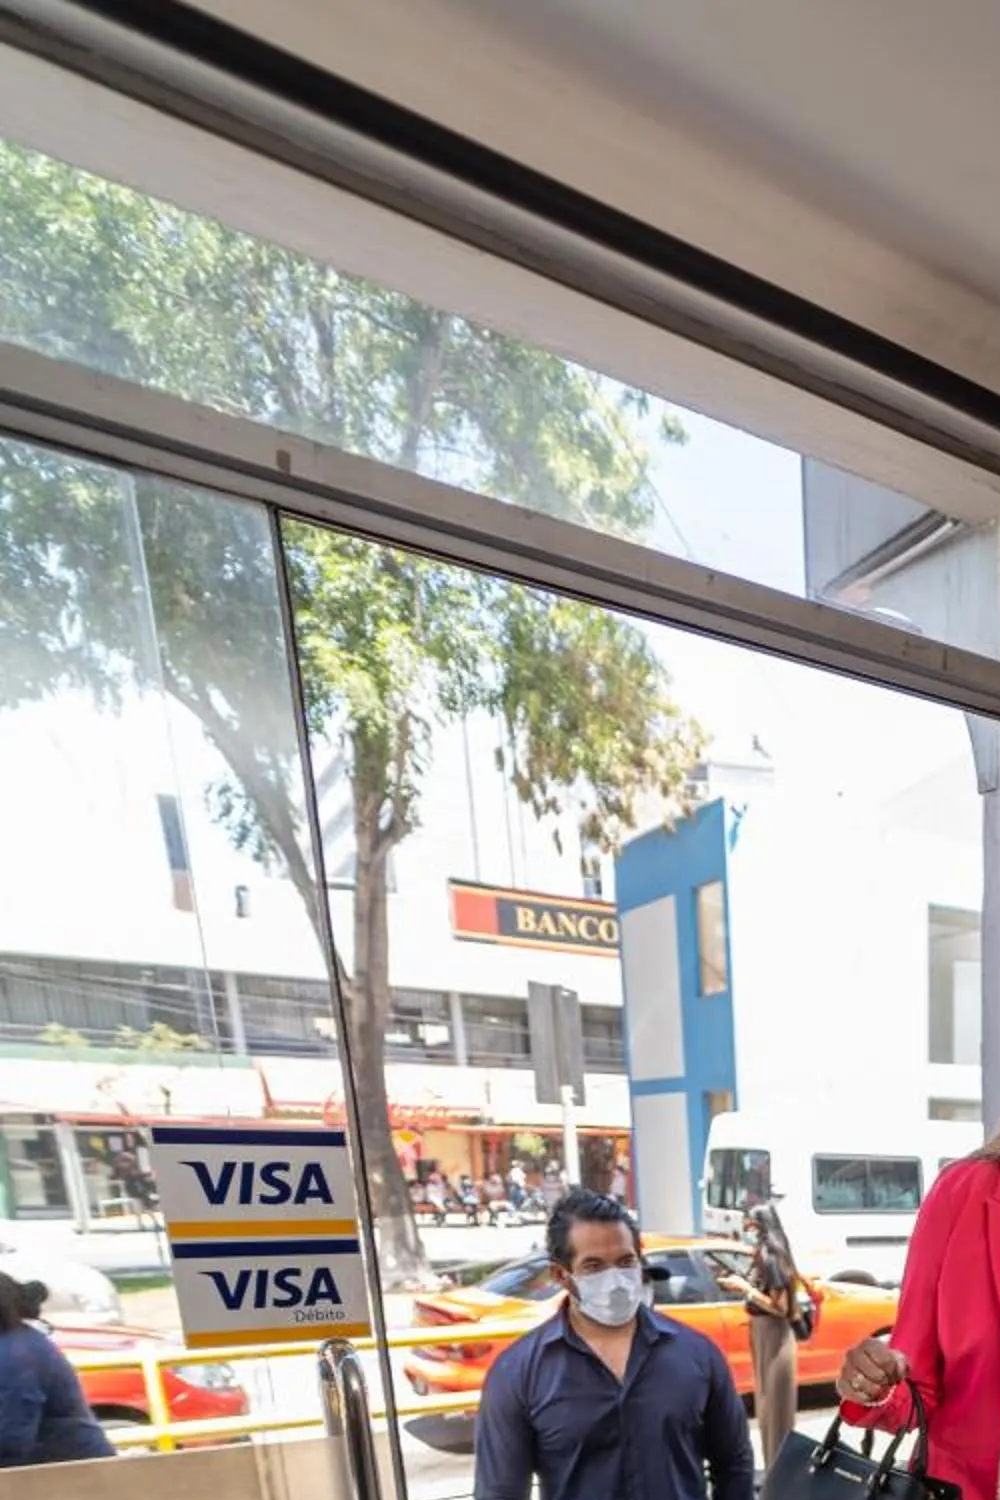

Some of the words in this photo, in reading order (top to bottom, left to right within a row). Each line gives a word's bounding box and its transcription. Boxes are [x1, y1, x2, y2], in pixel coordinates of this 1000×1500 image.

[515, 906, 619, 943] BANCO
[178, 1161, 334, 1205] VISA
[198, 1267, 342, 1310] VISA
[294, 1308, 346, 1323] Débito
